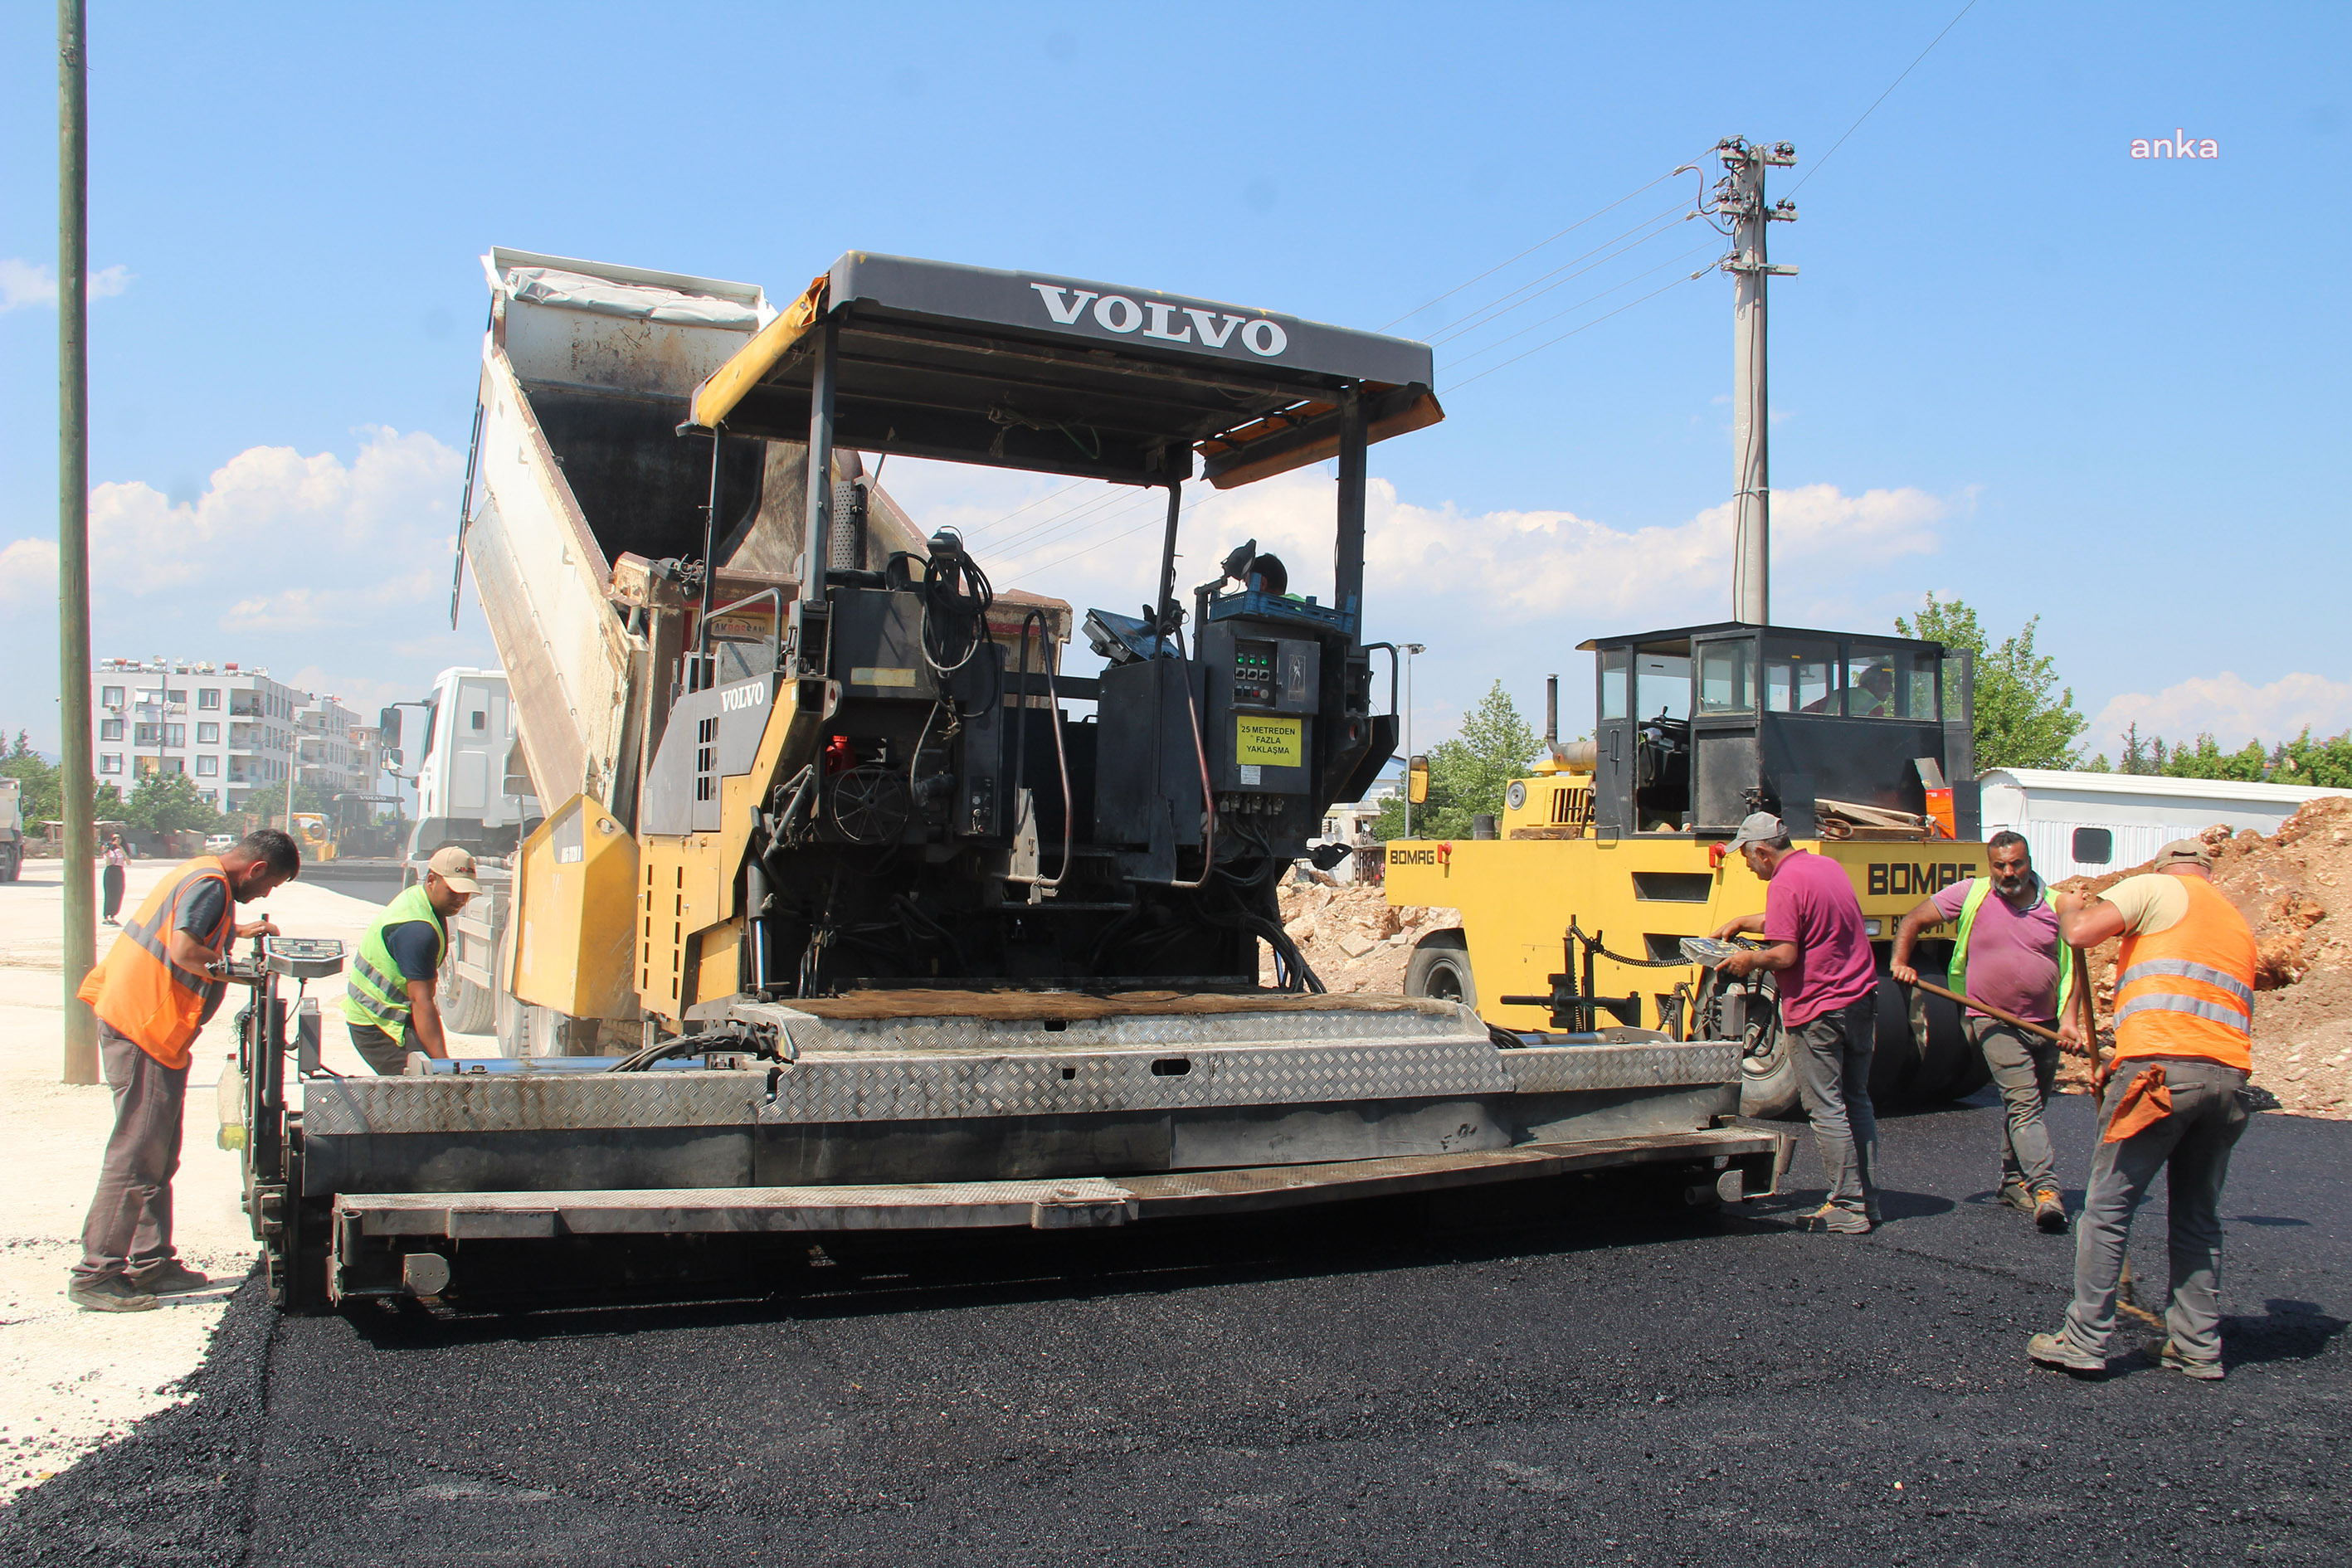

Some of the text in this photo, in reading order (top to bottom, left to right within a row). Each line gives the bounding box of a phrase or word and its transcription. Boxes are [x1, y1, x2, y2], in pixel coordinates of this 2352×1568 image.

[1030, 281, 1288, 357] VOLVO
[720, 681, 765, 713] VOLVO
[1252, 727, 1296, 735] METREDEN
[1255, 736, 1282, 744] FAZLA
[1246, 745, 1290, 755] YAKLAŞMA
[1390, 850, 1434, 864] BOMAG
